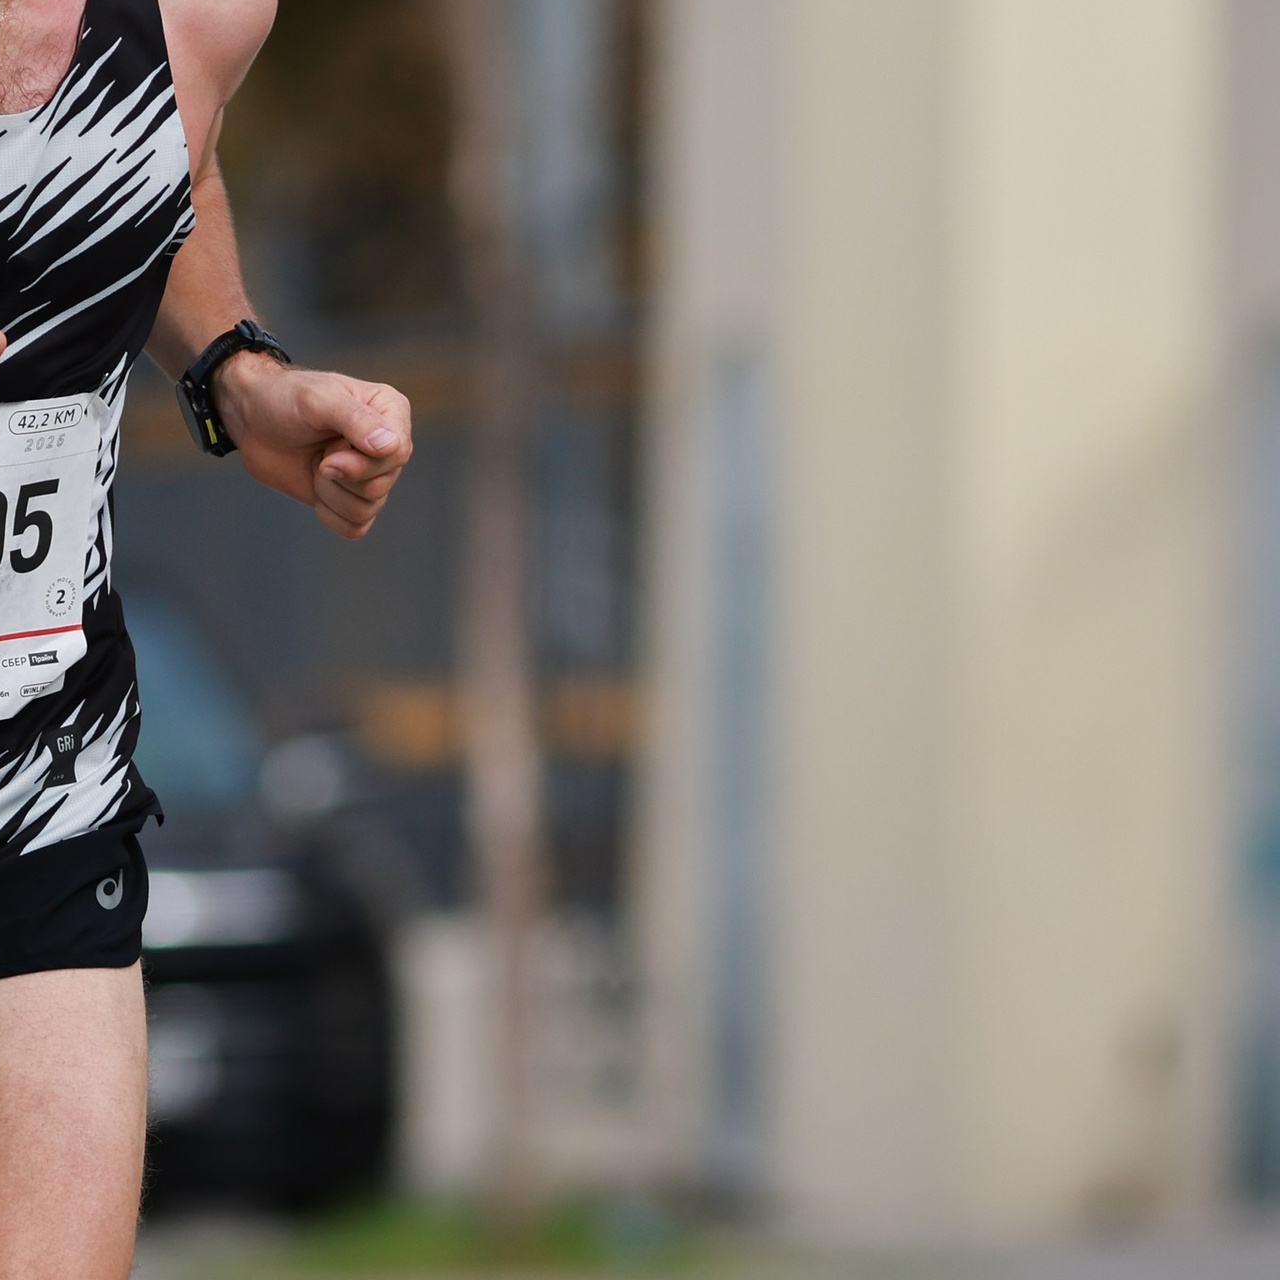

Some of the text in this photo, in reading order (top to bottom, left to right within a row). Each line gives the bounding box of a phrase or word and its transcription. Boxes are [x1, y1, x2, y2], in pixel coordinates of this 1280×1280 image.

[17, 408, 76, 430] 42,2 КМ
[24, 433, 66, 453] 2026
[55, 589, 66, 605] 2
[1, 654, 54, 668] СБЕР Прайм
